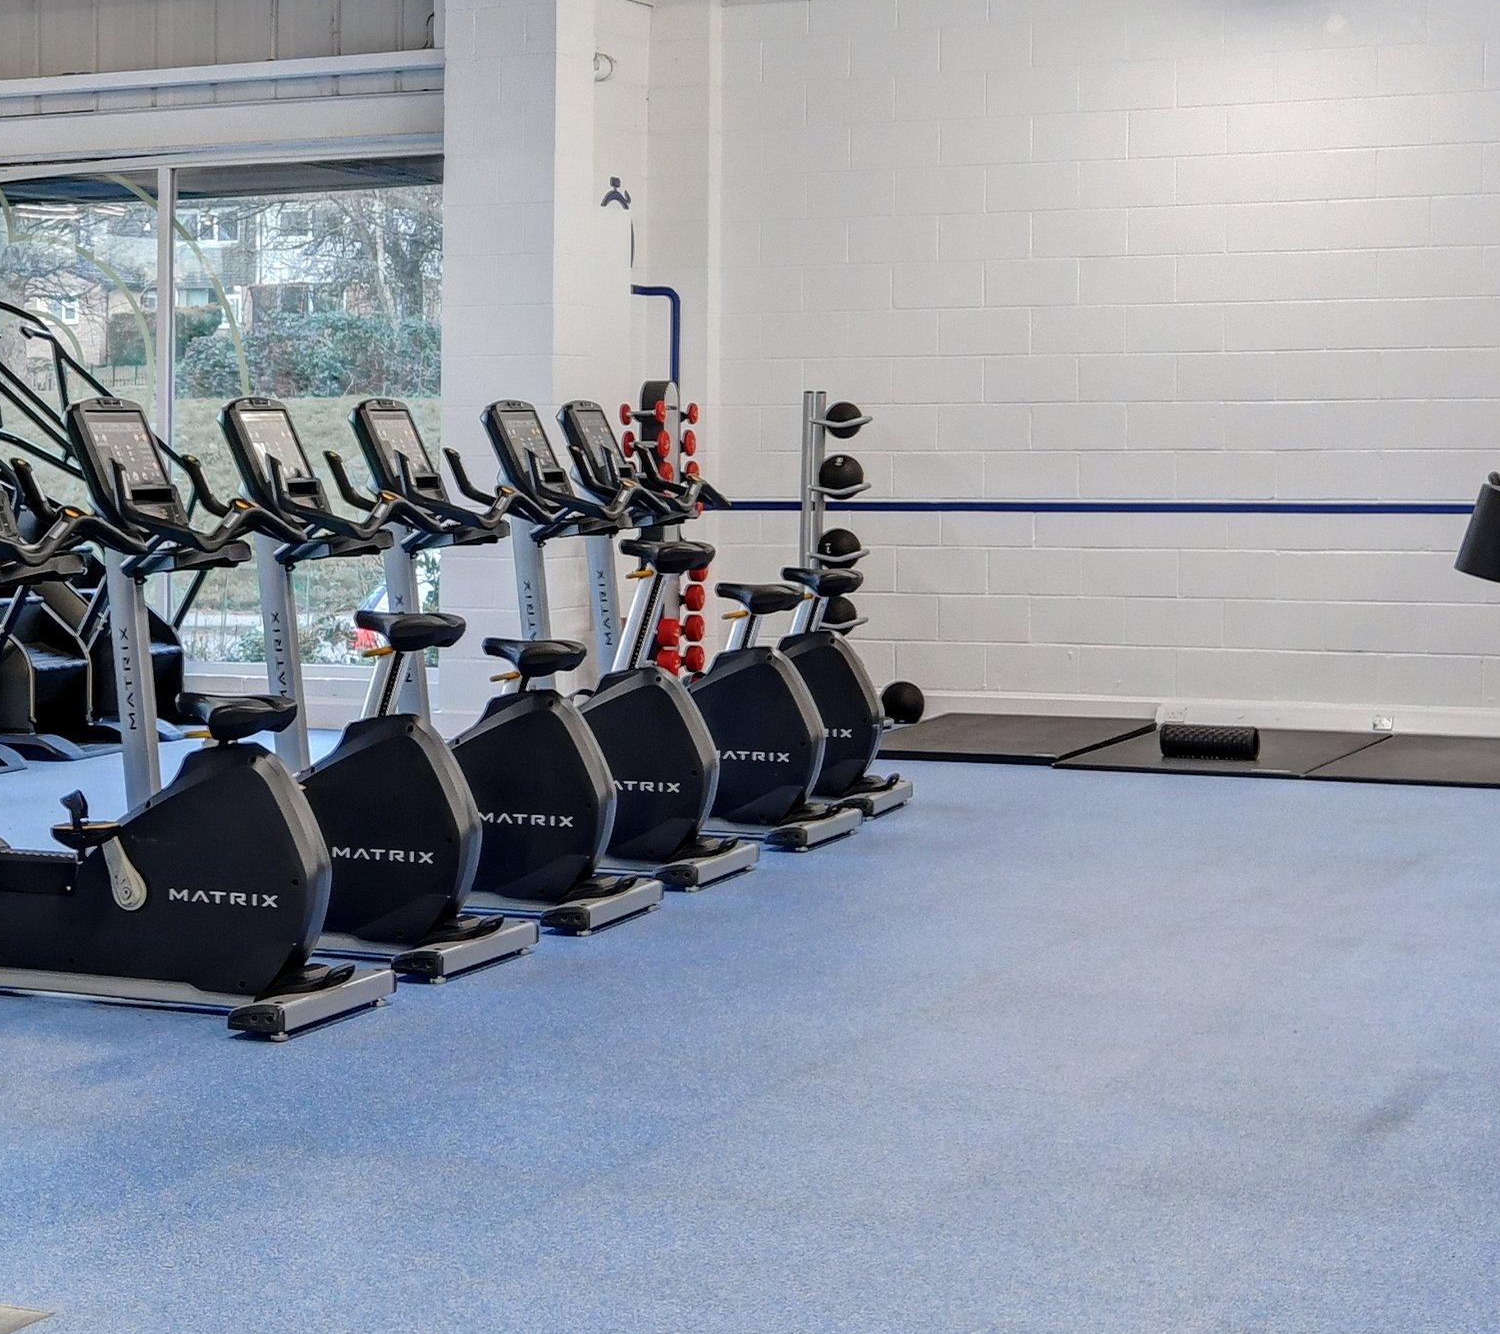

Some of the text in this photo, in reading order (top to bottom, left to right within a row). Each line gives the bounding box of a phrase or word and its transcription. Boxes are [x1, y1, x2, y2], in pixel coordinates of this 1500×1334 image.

[523, 579, 537, 642] ATRIX
[597, 569, 614, 647] MATRIX
[119, 627, 138, 731] MATRIX
[612, 779, 681, 794] ATRIX
[478, 811, 575, 829] MATRIX
[332, 846, 434, 866] MATRIX
[168, 886, 279, 908] MATRIX
